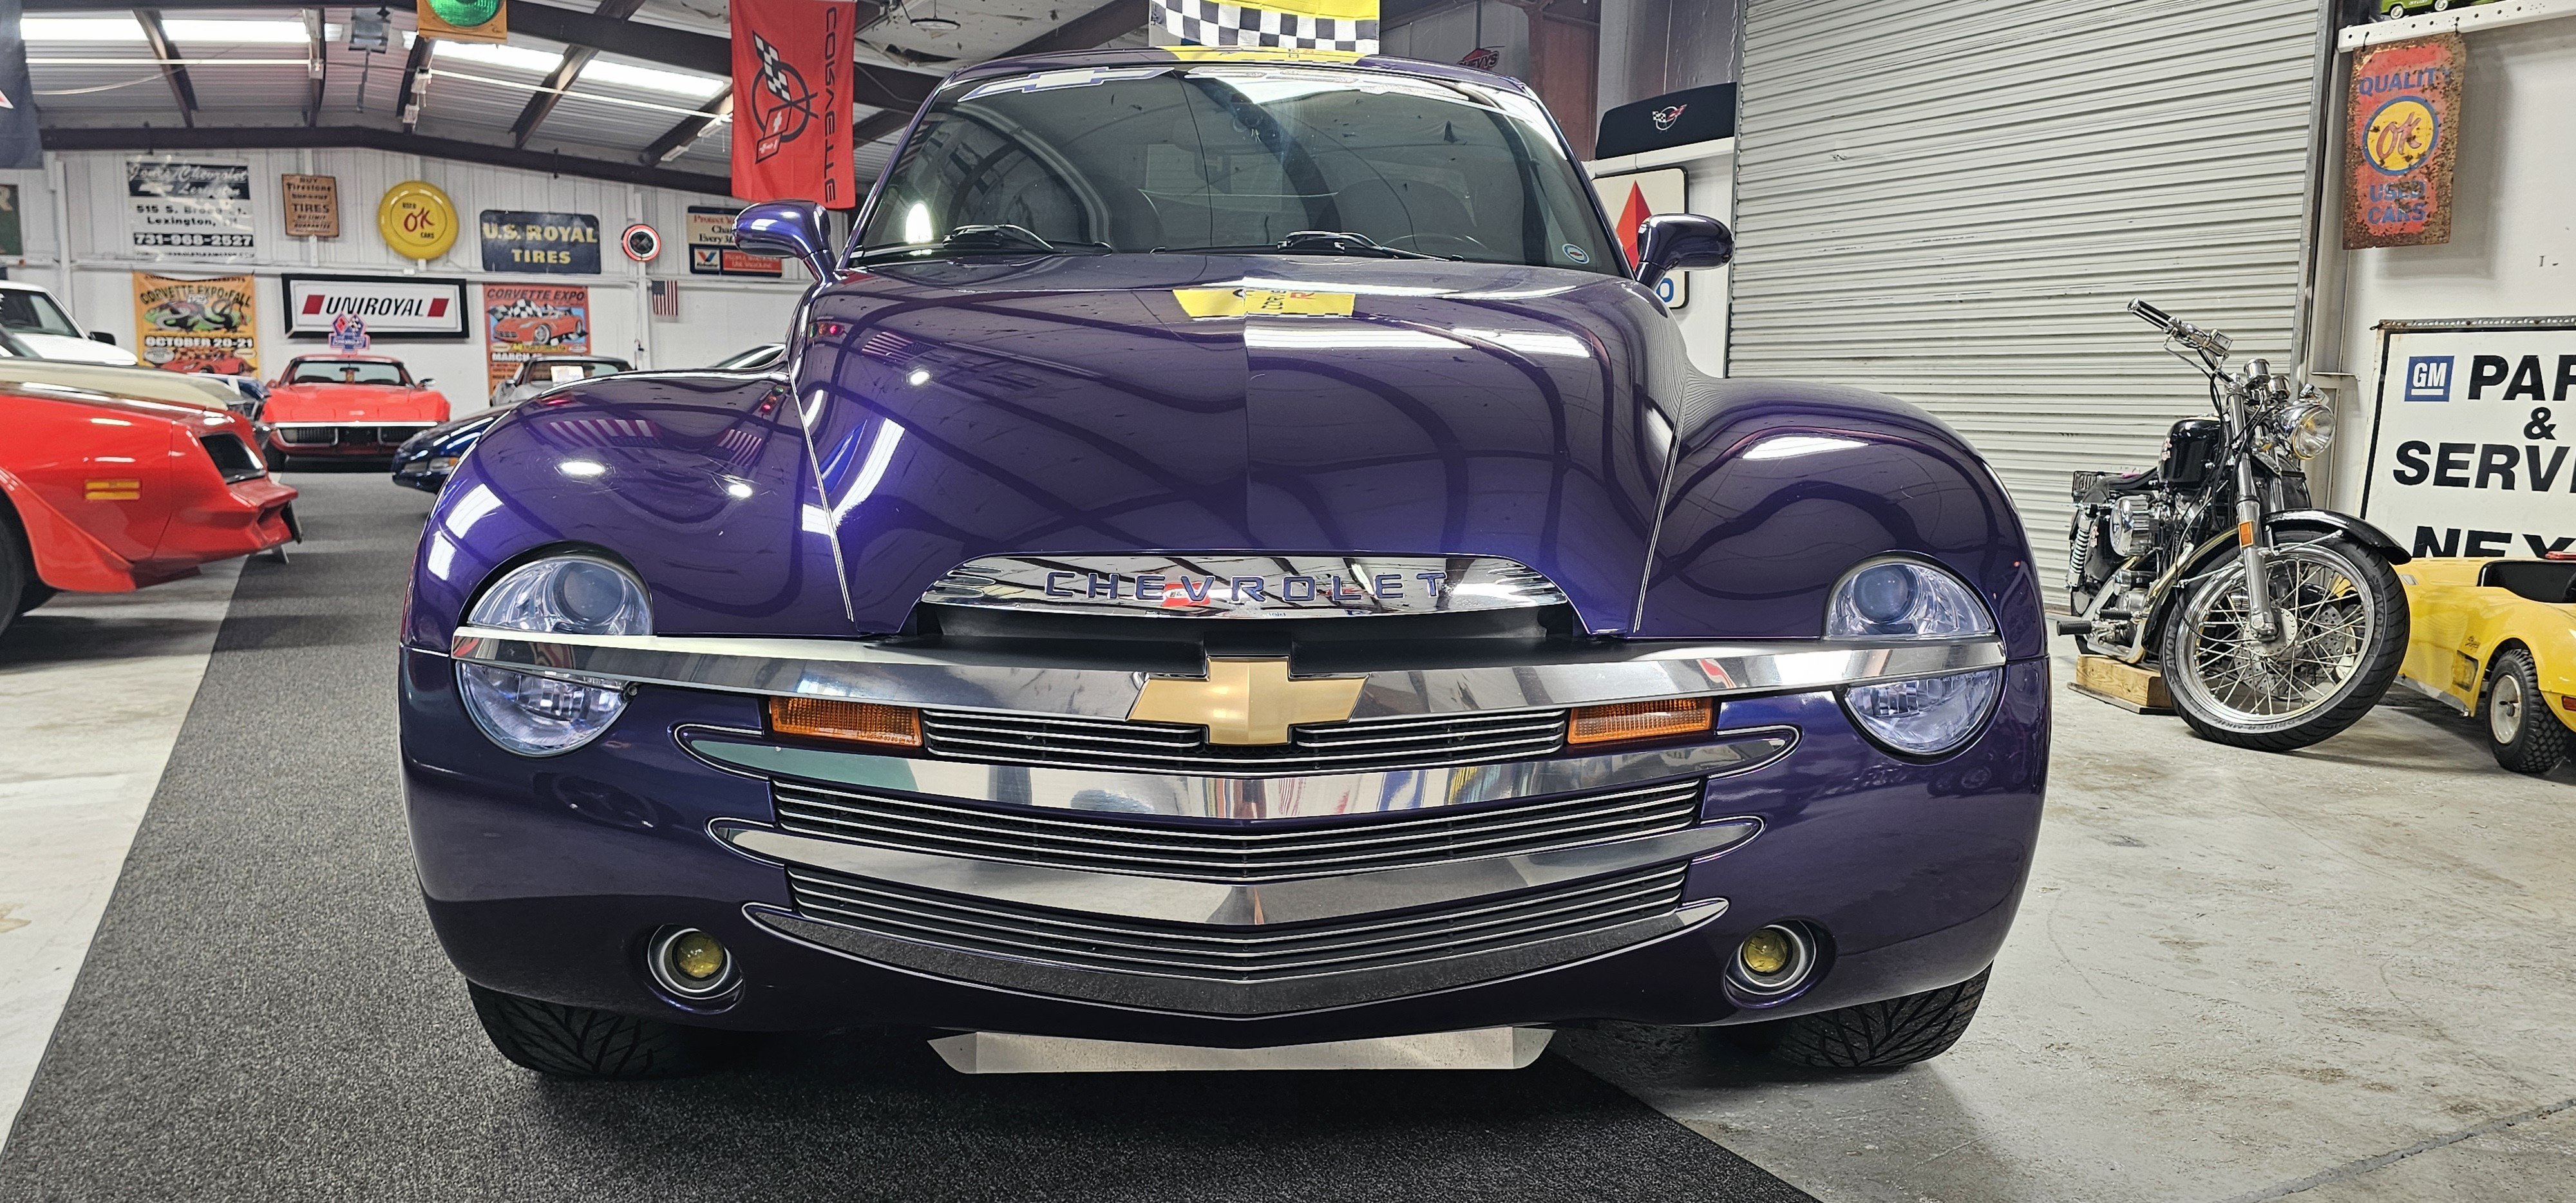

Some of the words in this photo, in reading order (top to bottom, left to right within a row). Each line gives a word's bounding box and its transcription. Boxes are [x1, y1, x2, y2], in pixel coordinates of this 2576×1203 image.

[2359, 67, 2452, 96] QUALITY
[824, 6, 837, 204] CORVETTE
[2376, 111, 2421, 160] OK
[2370, 180, 2425, 202] USED
[137, 205, 159, 213] 515
[292, 204, 330, 213] TIRES
[2367, 203, 2426, 224] CARS
[147, 216, 216, 227] Lexington,
[404, 207, 435, 232] OK
[483, 223, 522, 240] U.S.
[526, 225, 598, 243] ROYAL
[699, 234, 723, 243] Every
[511, 249, 571, 264] TIRES
[140, 285, 193, 305] CORVETTE
[487, 289, 549, 301] CORVETTE
[554, 290, 584, 301] EXPO
[326, 296, 424, 317] UNIROYAL
[145, 336, 211, 348] OCTOBER
[213, 337, 253, 348] 20-21
[2412, 363, 2447, 388] GM
[2523, 406, 2557, 440] &
[2393, 440, 2576, 493] SERV
[1045, 571, 1446, 602] CHEVROLET
[2373, 592, 2385, 639] AVON
[2164, 624, 2178, 670] AVON
